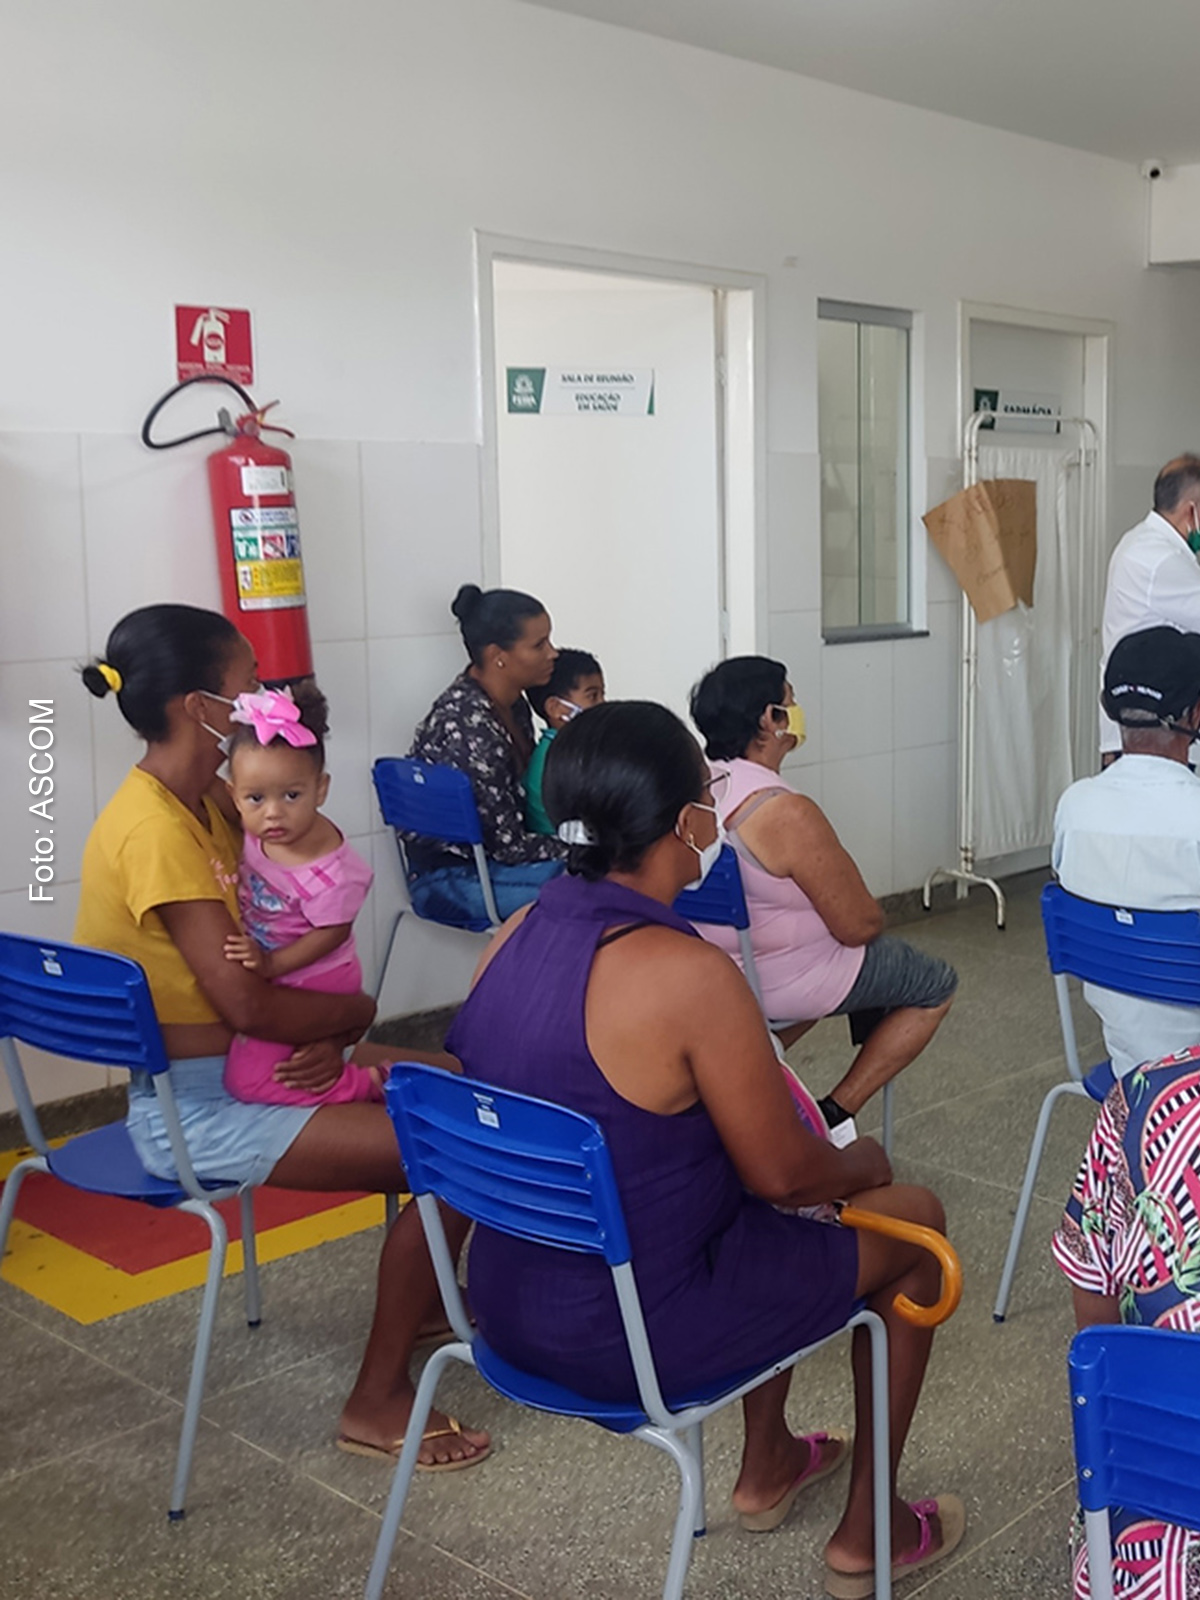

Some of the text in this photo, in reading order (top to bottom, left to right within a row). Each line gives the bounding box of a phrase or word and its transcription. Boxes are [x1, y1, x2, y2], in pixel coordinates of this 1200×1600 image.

[561, 372, 634, 384] SALA DE REUNIÃO
